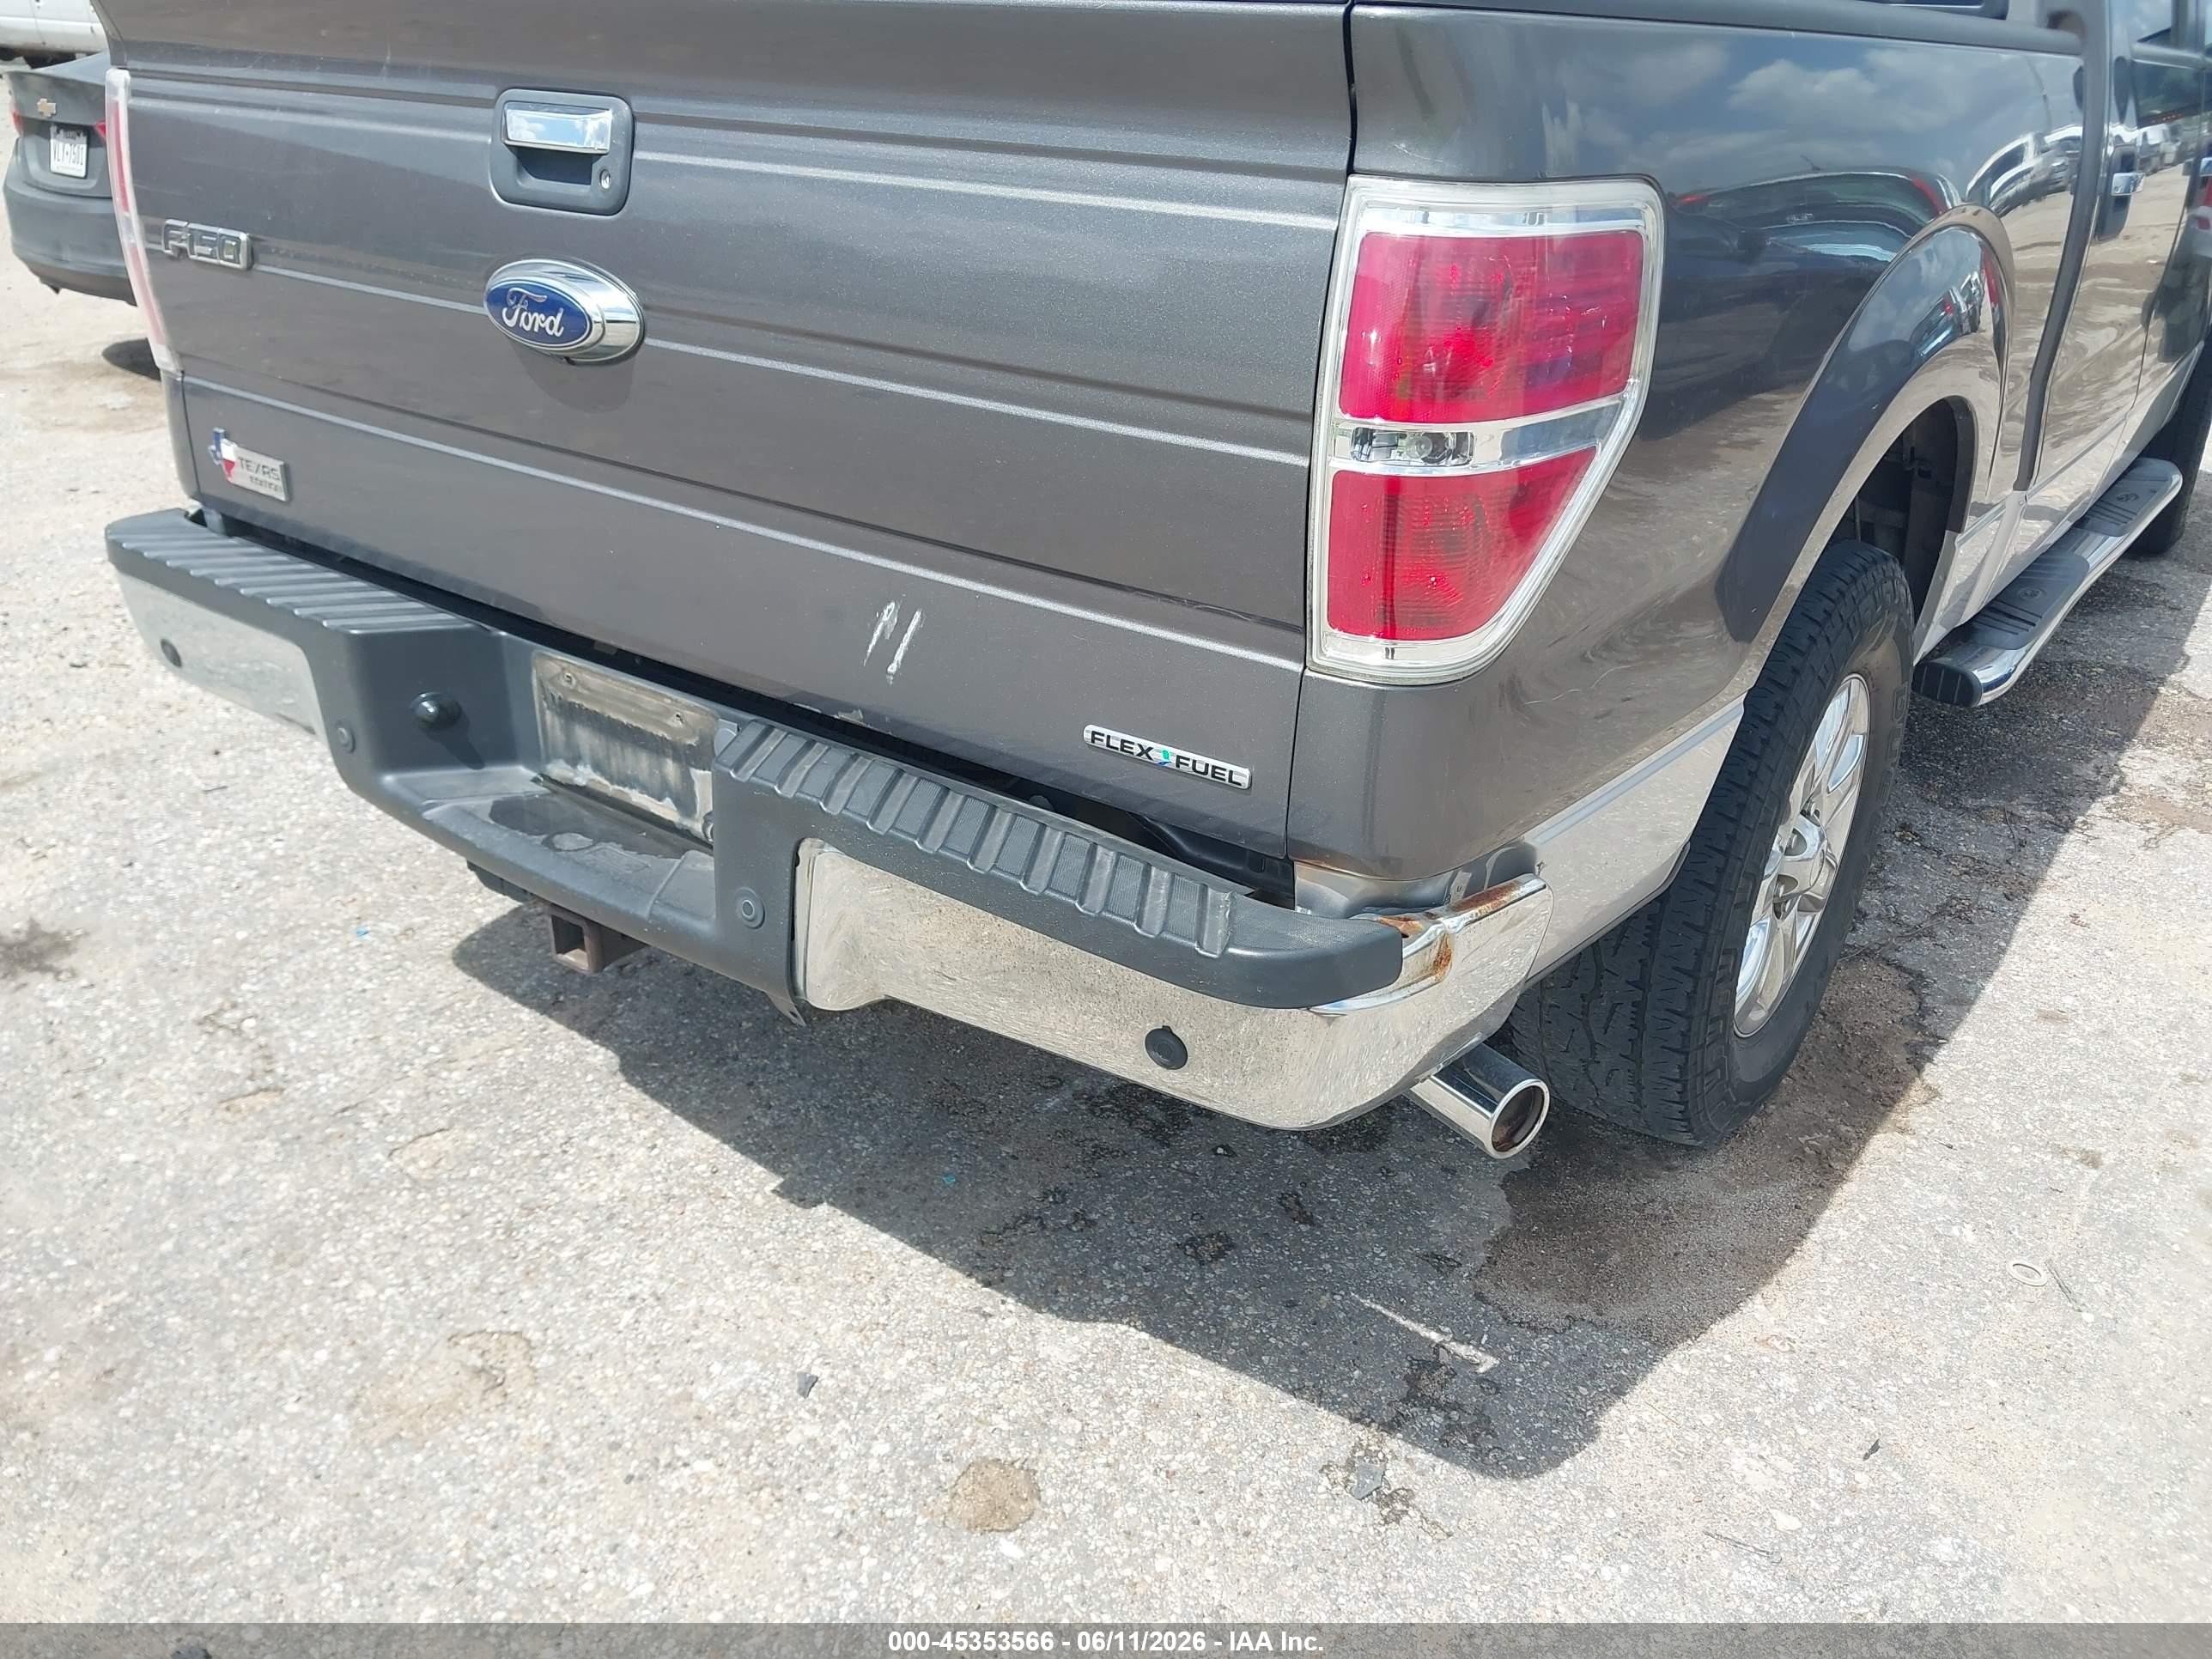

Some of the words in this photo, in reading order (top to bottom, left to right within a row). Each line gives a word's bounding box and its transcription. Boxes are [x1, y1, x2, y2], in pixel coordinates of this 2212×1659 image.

[501, 287, 564, 337] Ford
[1091, 730, 1154, 761] FLEX
[1175, 754, 1243, 787] FUEL
